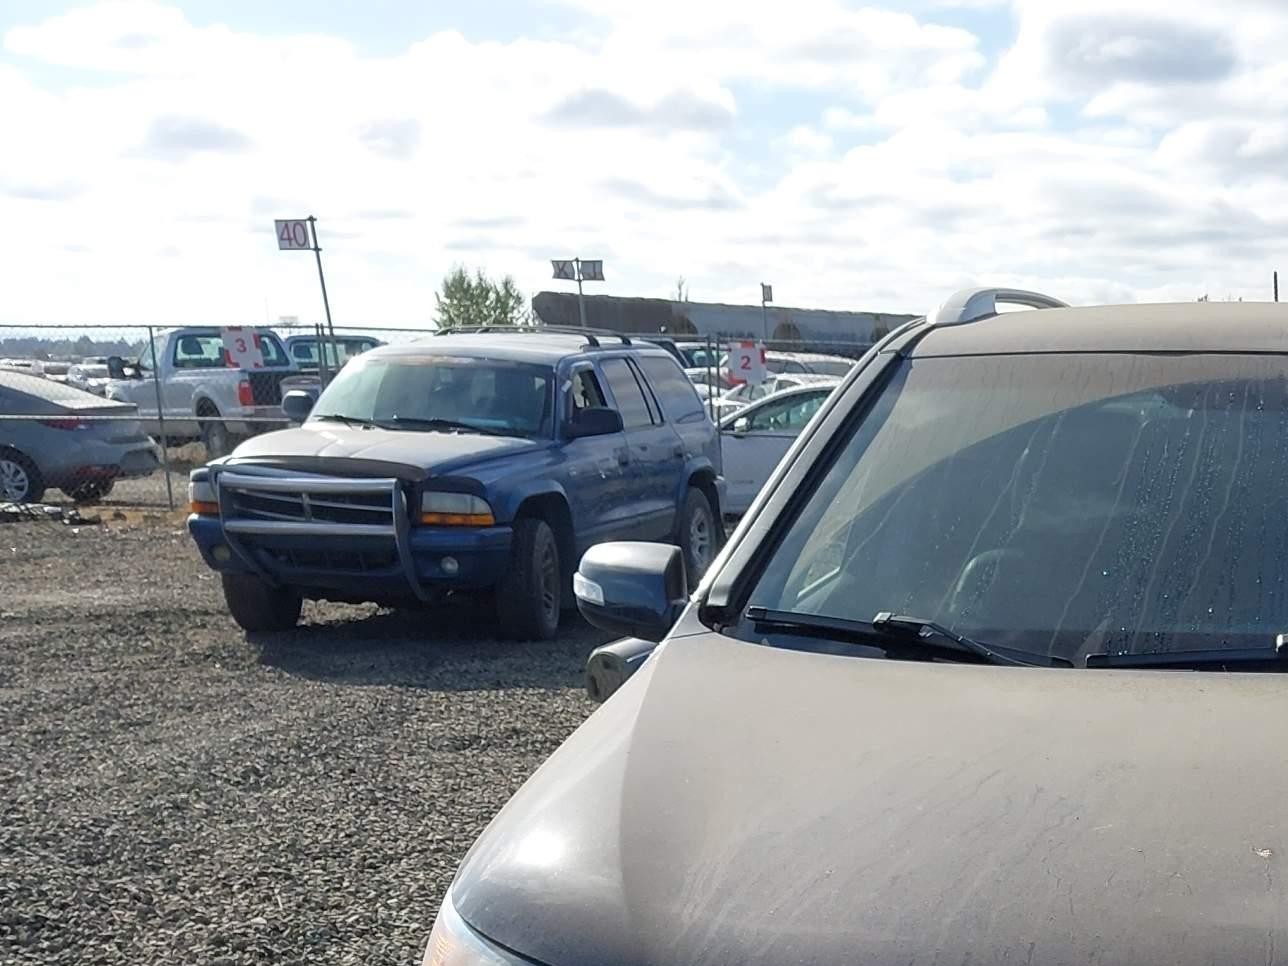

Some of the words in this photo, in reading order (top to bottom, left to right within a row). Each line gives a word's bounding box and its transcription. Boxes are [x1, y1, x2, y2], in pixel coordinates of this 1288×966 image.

[280, 222, 307, 247] 40
[235, 338, 247, 352] 3
[740, 355, 752, 370] 2
